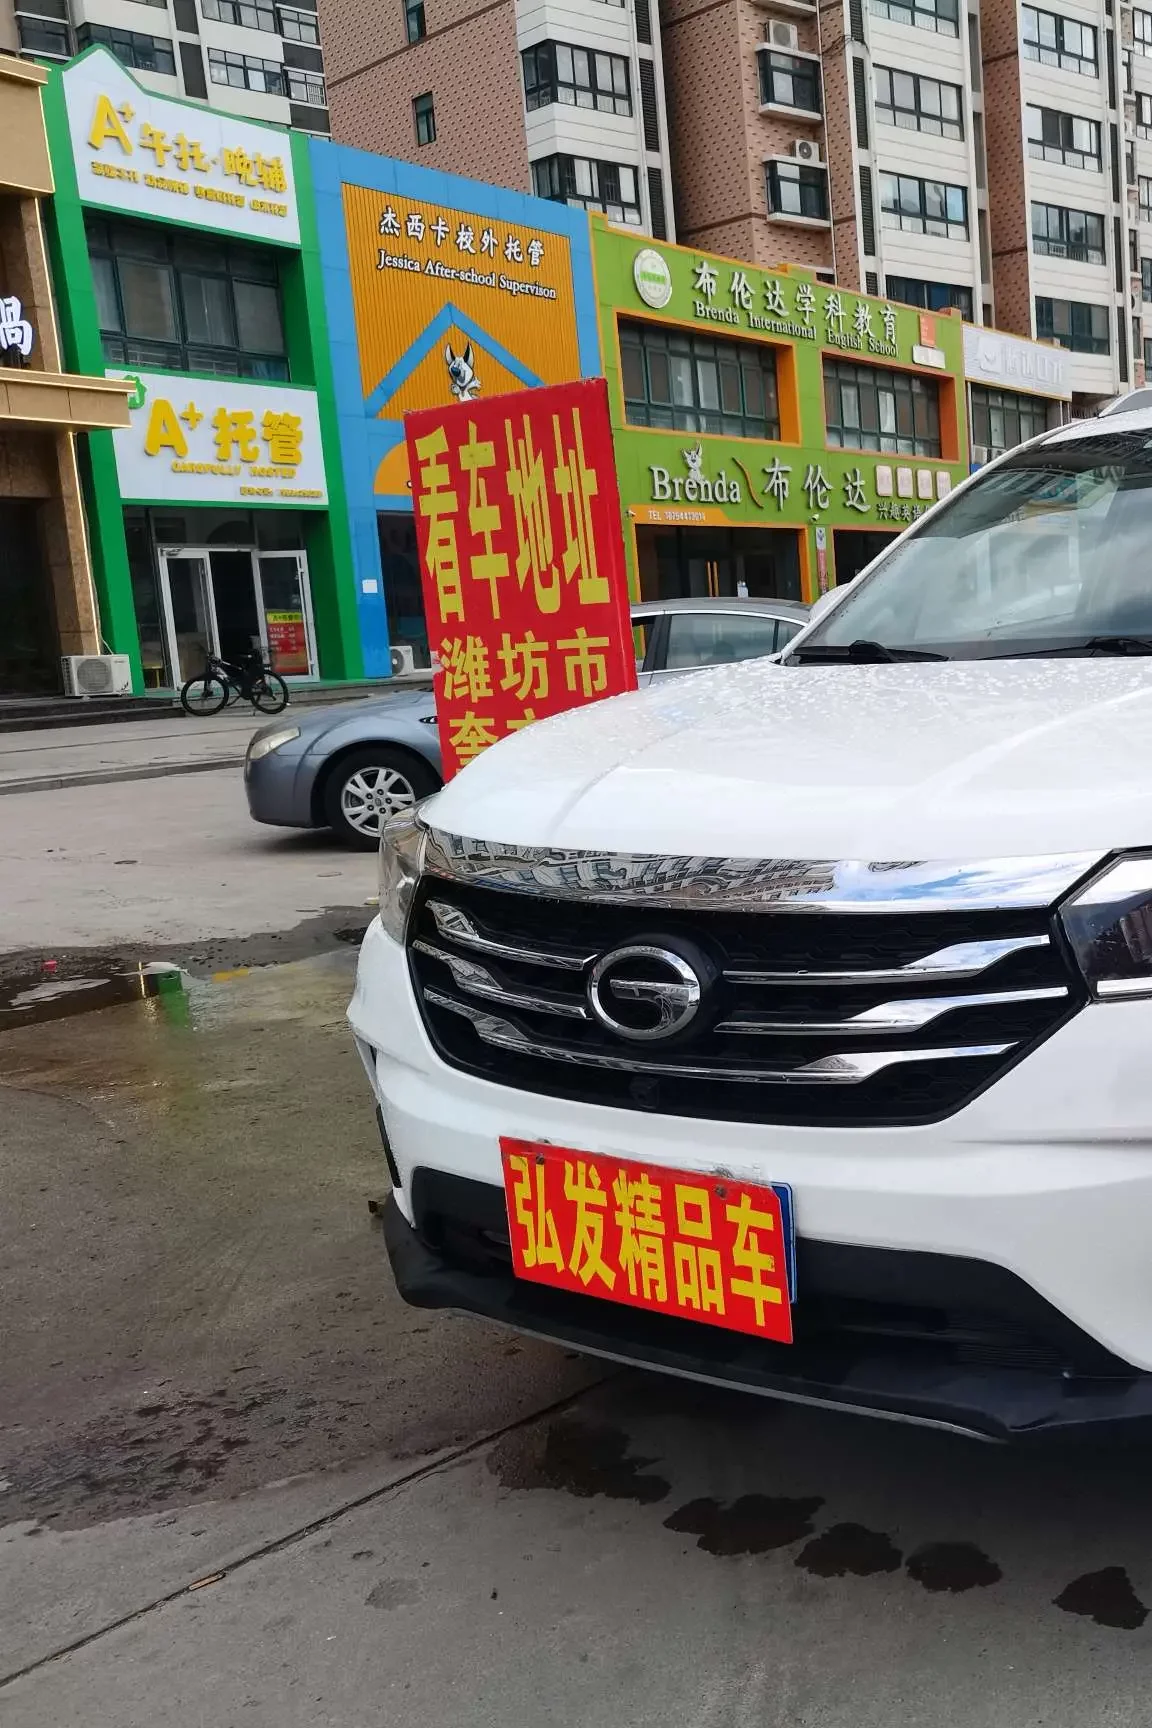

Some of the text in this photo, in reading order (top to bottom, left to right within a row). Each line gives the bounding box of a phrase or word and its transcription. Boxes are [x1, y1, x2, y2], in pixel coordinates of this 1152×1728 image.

[379, 205, 545, 266] 杰西卡校外托管
[377, 250, 421, 272] Jessica
[424, 260, 496, 288] After-school
[693, 260, 898, 345] 布伦达学科教育
[693, 300, 899, 358] Brenda International English School
[649, 466, 742, 504] Brenda
[762, 456, 872, 515] 布伦达
[877, 502, 931, 521] 兴趣英语
[414, 407, 611, 624] 看车地址
[440, 627, 610, 704] 潍坊市
[510, 1153, 783, 1327] 弘发精品车
